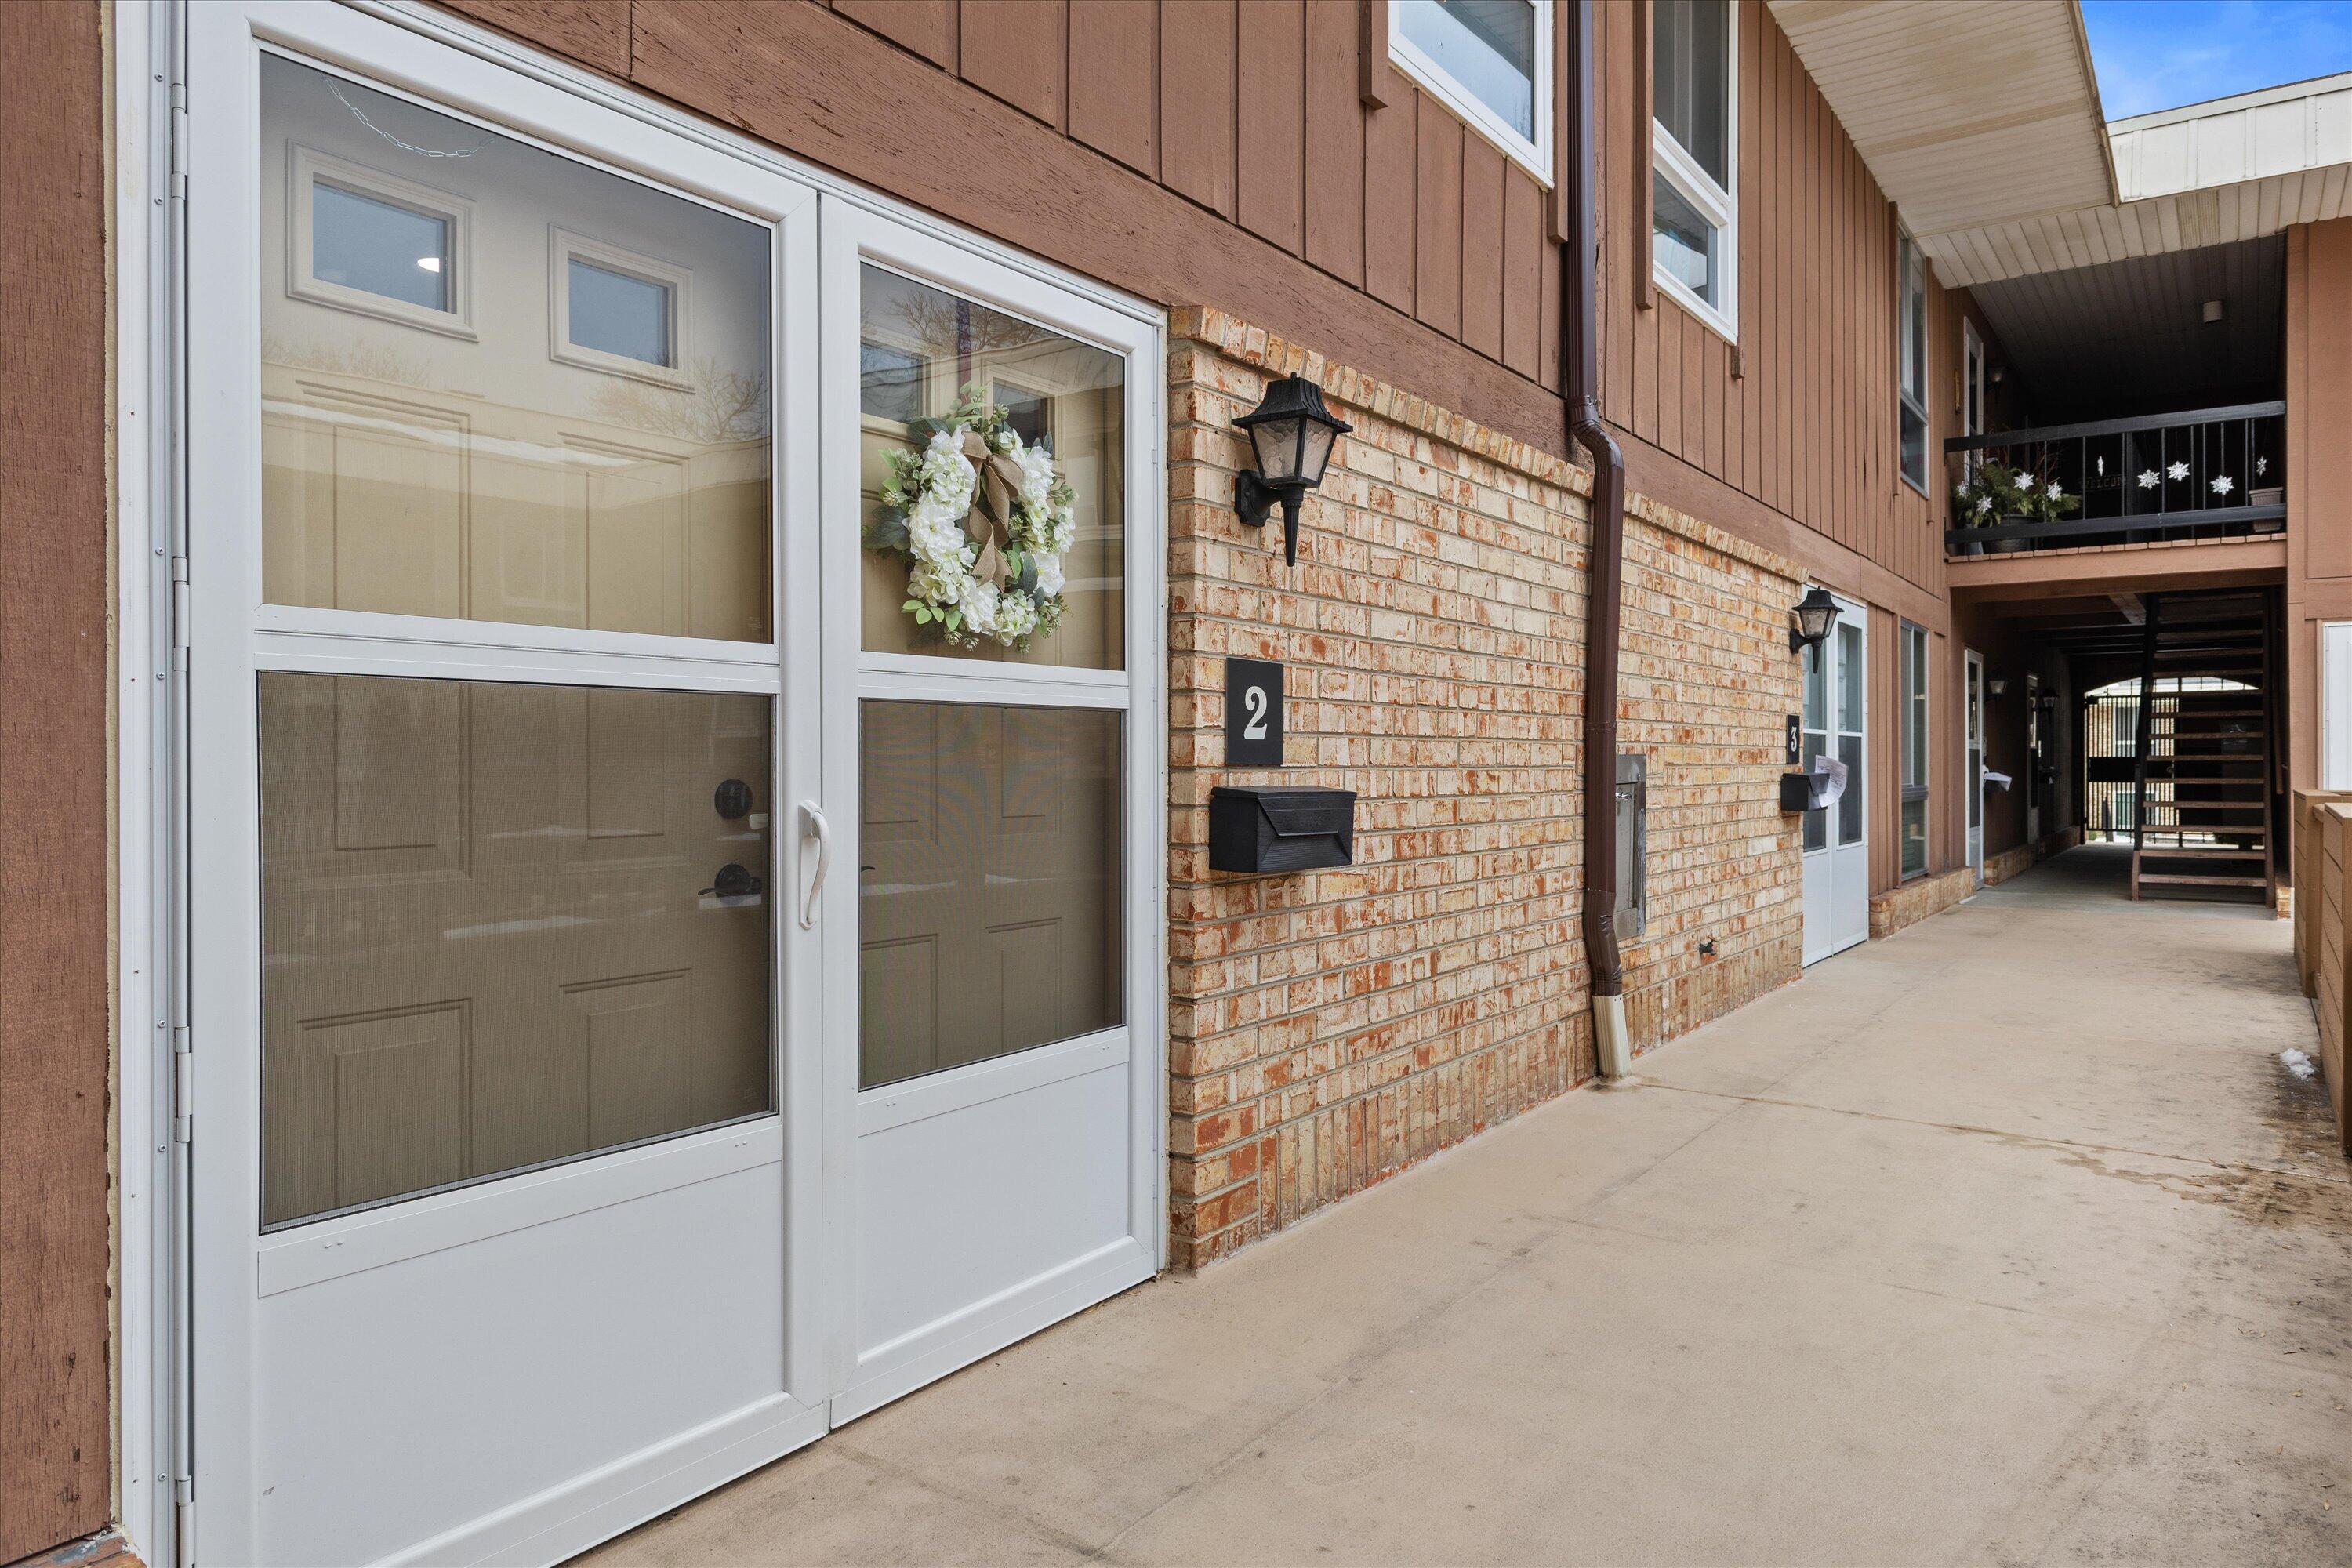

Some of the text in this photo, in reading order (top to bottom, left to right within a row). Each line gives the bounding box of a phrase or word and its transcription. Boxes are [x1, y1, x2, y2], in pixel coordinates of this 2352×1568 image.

[2078, 477, 2126, 489] WELCOM
[1244, 686, 1268, 739] 2
[1791, 726, 1797, 752] 3
